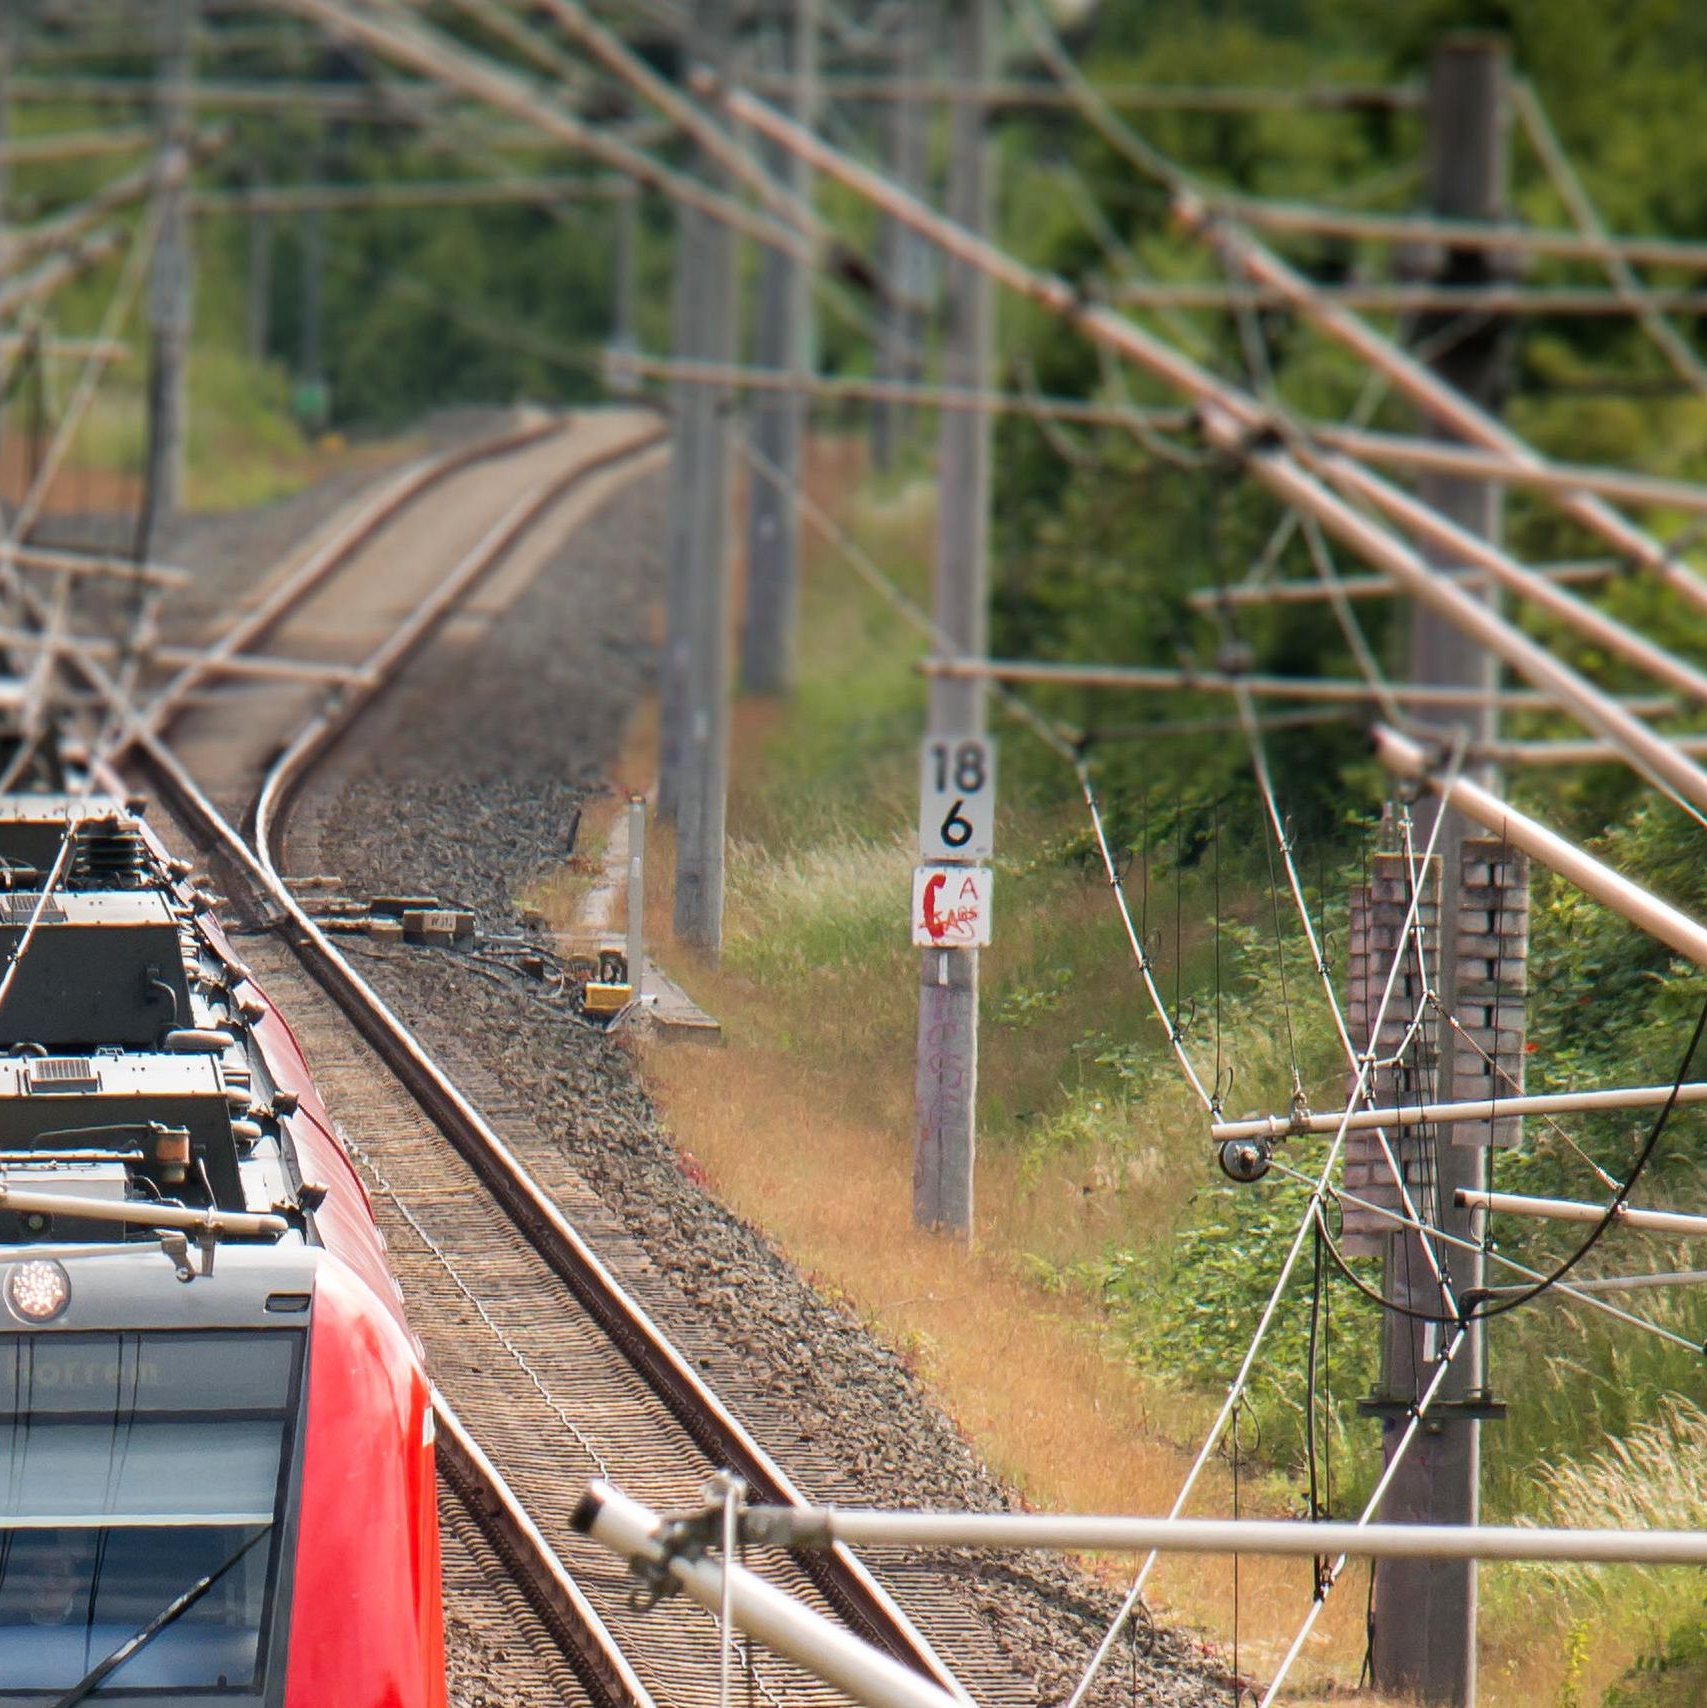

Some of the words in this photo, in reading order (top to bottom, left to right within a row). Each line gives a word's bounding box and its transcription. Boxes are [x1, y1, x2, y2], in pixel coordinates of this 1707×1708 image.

[933, 741, 986, 794] 18
[941, 799, 973, 848] 6
[959, 876, 979, 901] A
